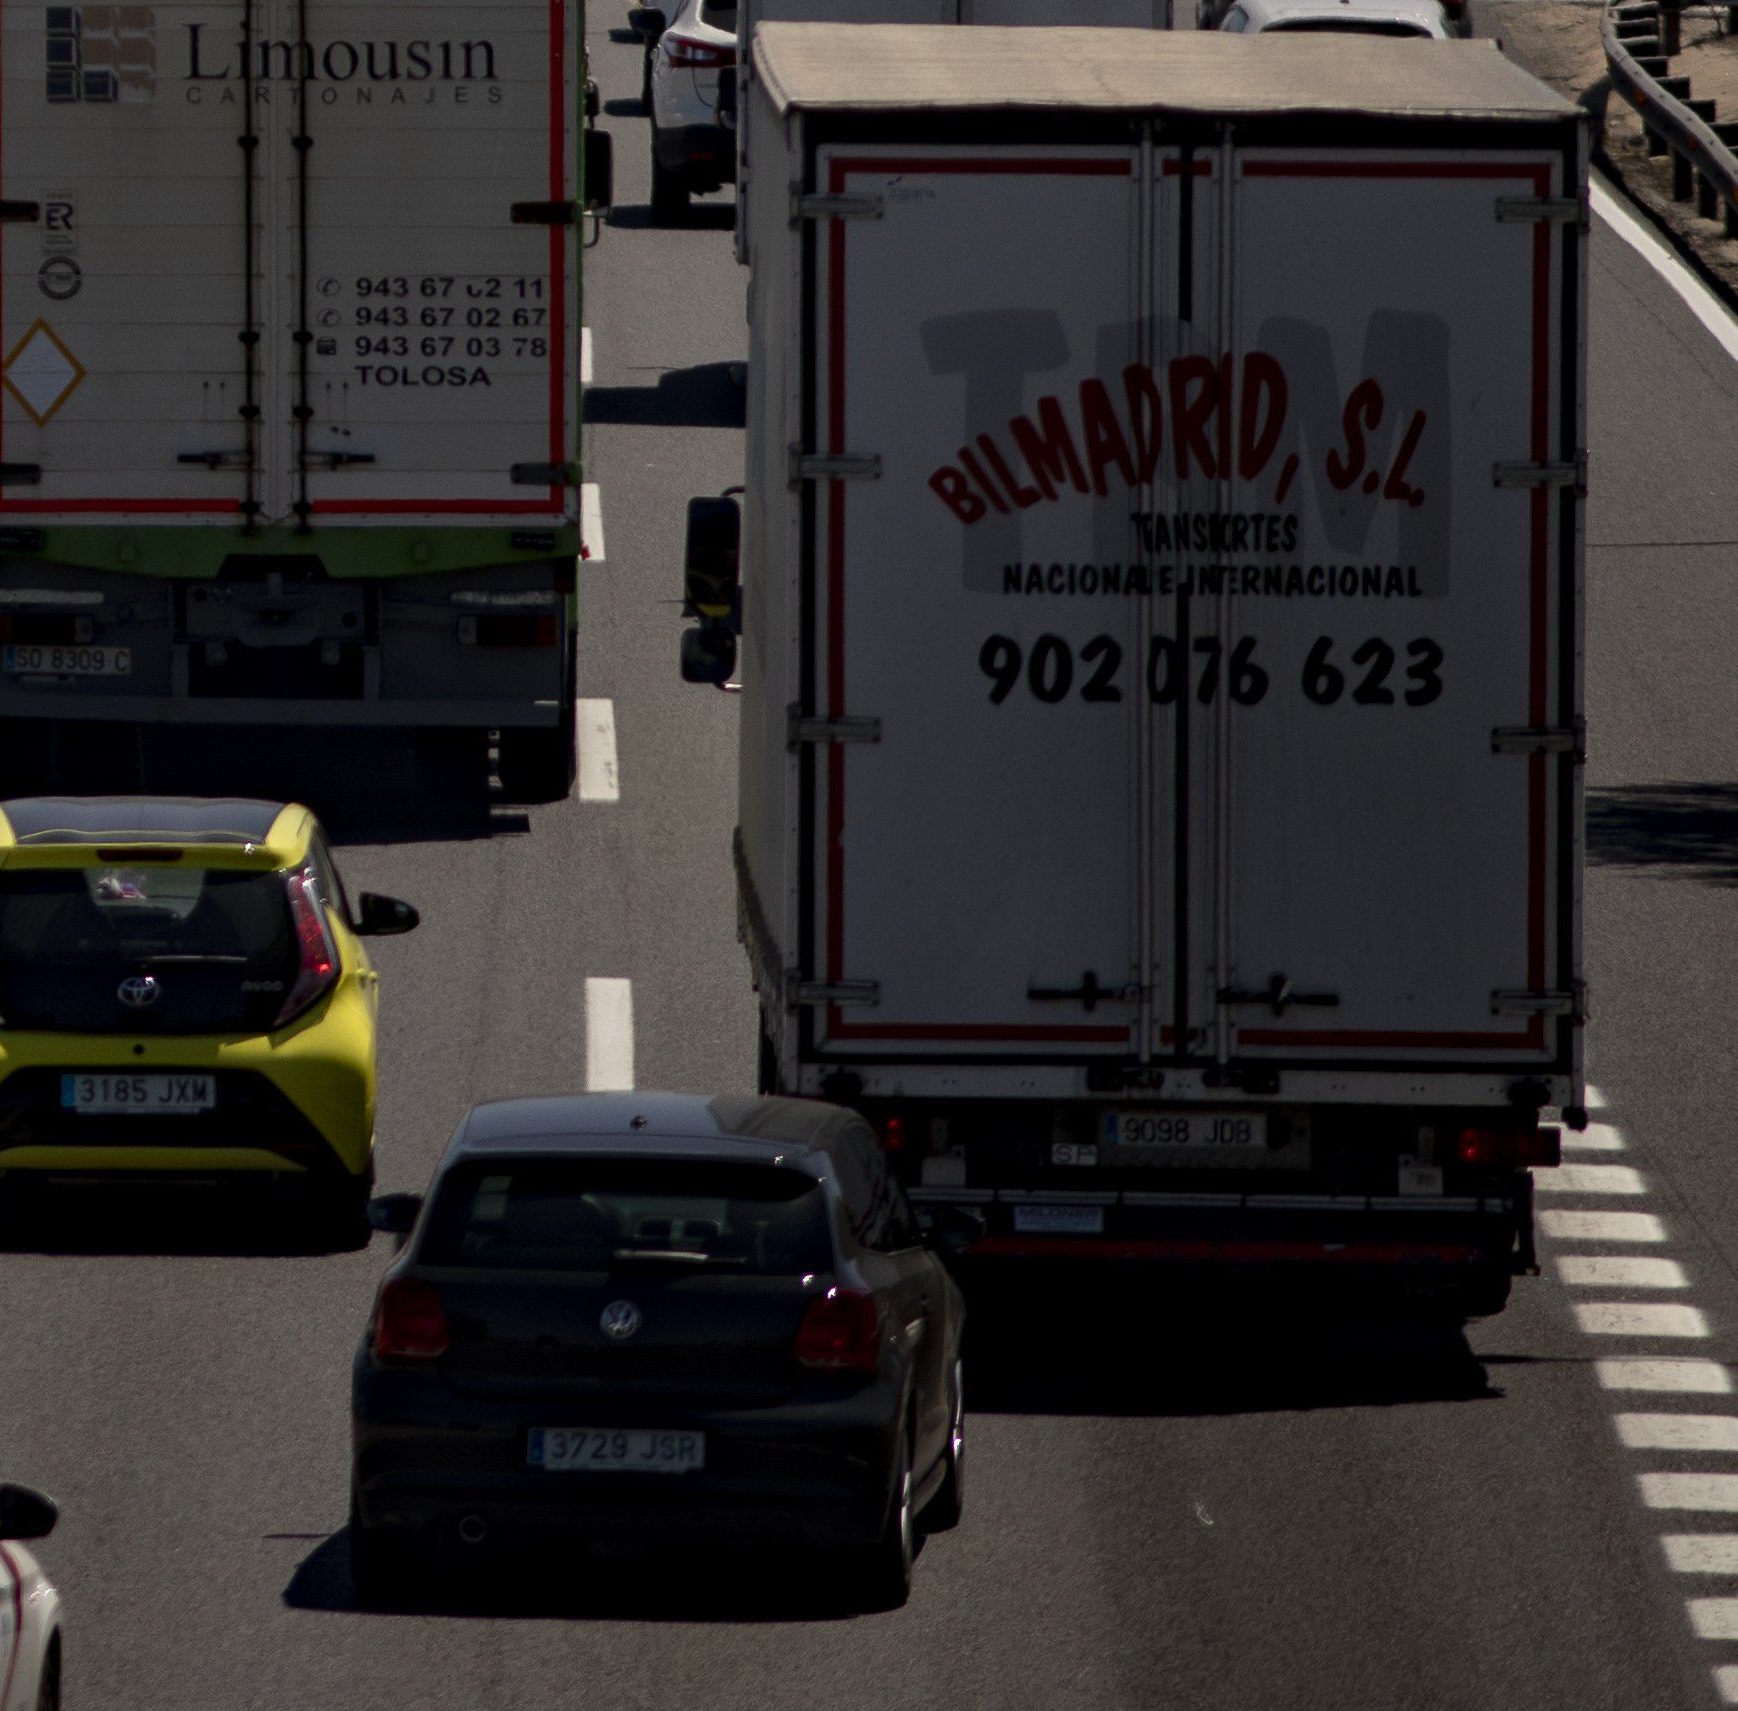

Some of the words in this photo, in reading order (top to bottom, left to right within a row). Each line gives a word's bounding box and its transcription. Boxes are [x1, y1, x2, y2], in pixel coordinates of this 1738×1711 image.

[356, 277, 409, 298] 943
[420, 277, 455, 298] 67
[513, 278, 543, 298] 11
[355, 306, 409, 327] 943
[420, 307, 455, 327] 67
[466, 307, 501, 328] 02
[512, 307, 547, 327] 67
[355, 336, 409, 357] 943
[420, 337, 455, 357] 67
[466, 337, 501, 358] 03
[512, 336, 547, 358] 78
[355, 365, 492, 387] TOLOSA
[929, 351, 1299, 525] BILMADRID,
[1326, 379, 1426, 507] S.L.
[51, 648, 105, 671] 8309
[114, 649, 129, 671] C
[980, 633, 1122, 705] 902
[1147, 635, 1269, 706] 076
[1302, 635, 1444, 706] 623
[81, 1079, 148, 1104] 3185
[157, 1079, 208, 1104] JXM
[1125, 1118, 1190, 1143] 9098
[1204, 1118, 1252, 1144] JDB
[550, 1428, 629, 1459] 3729
[640, 1429, 698, 1461] JSR
